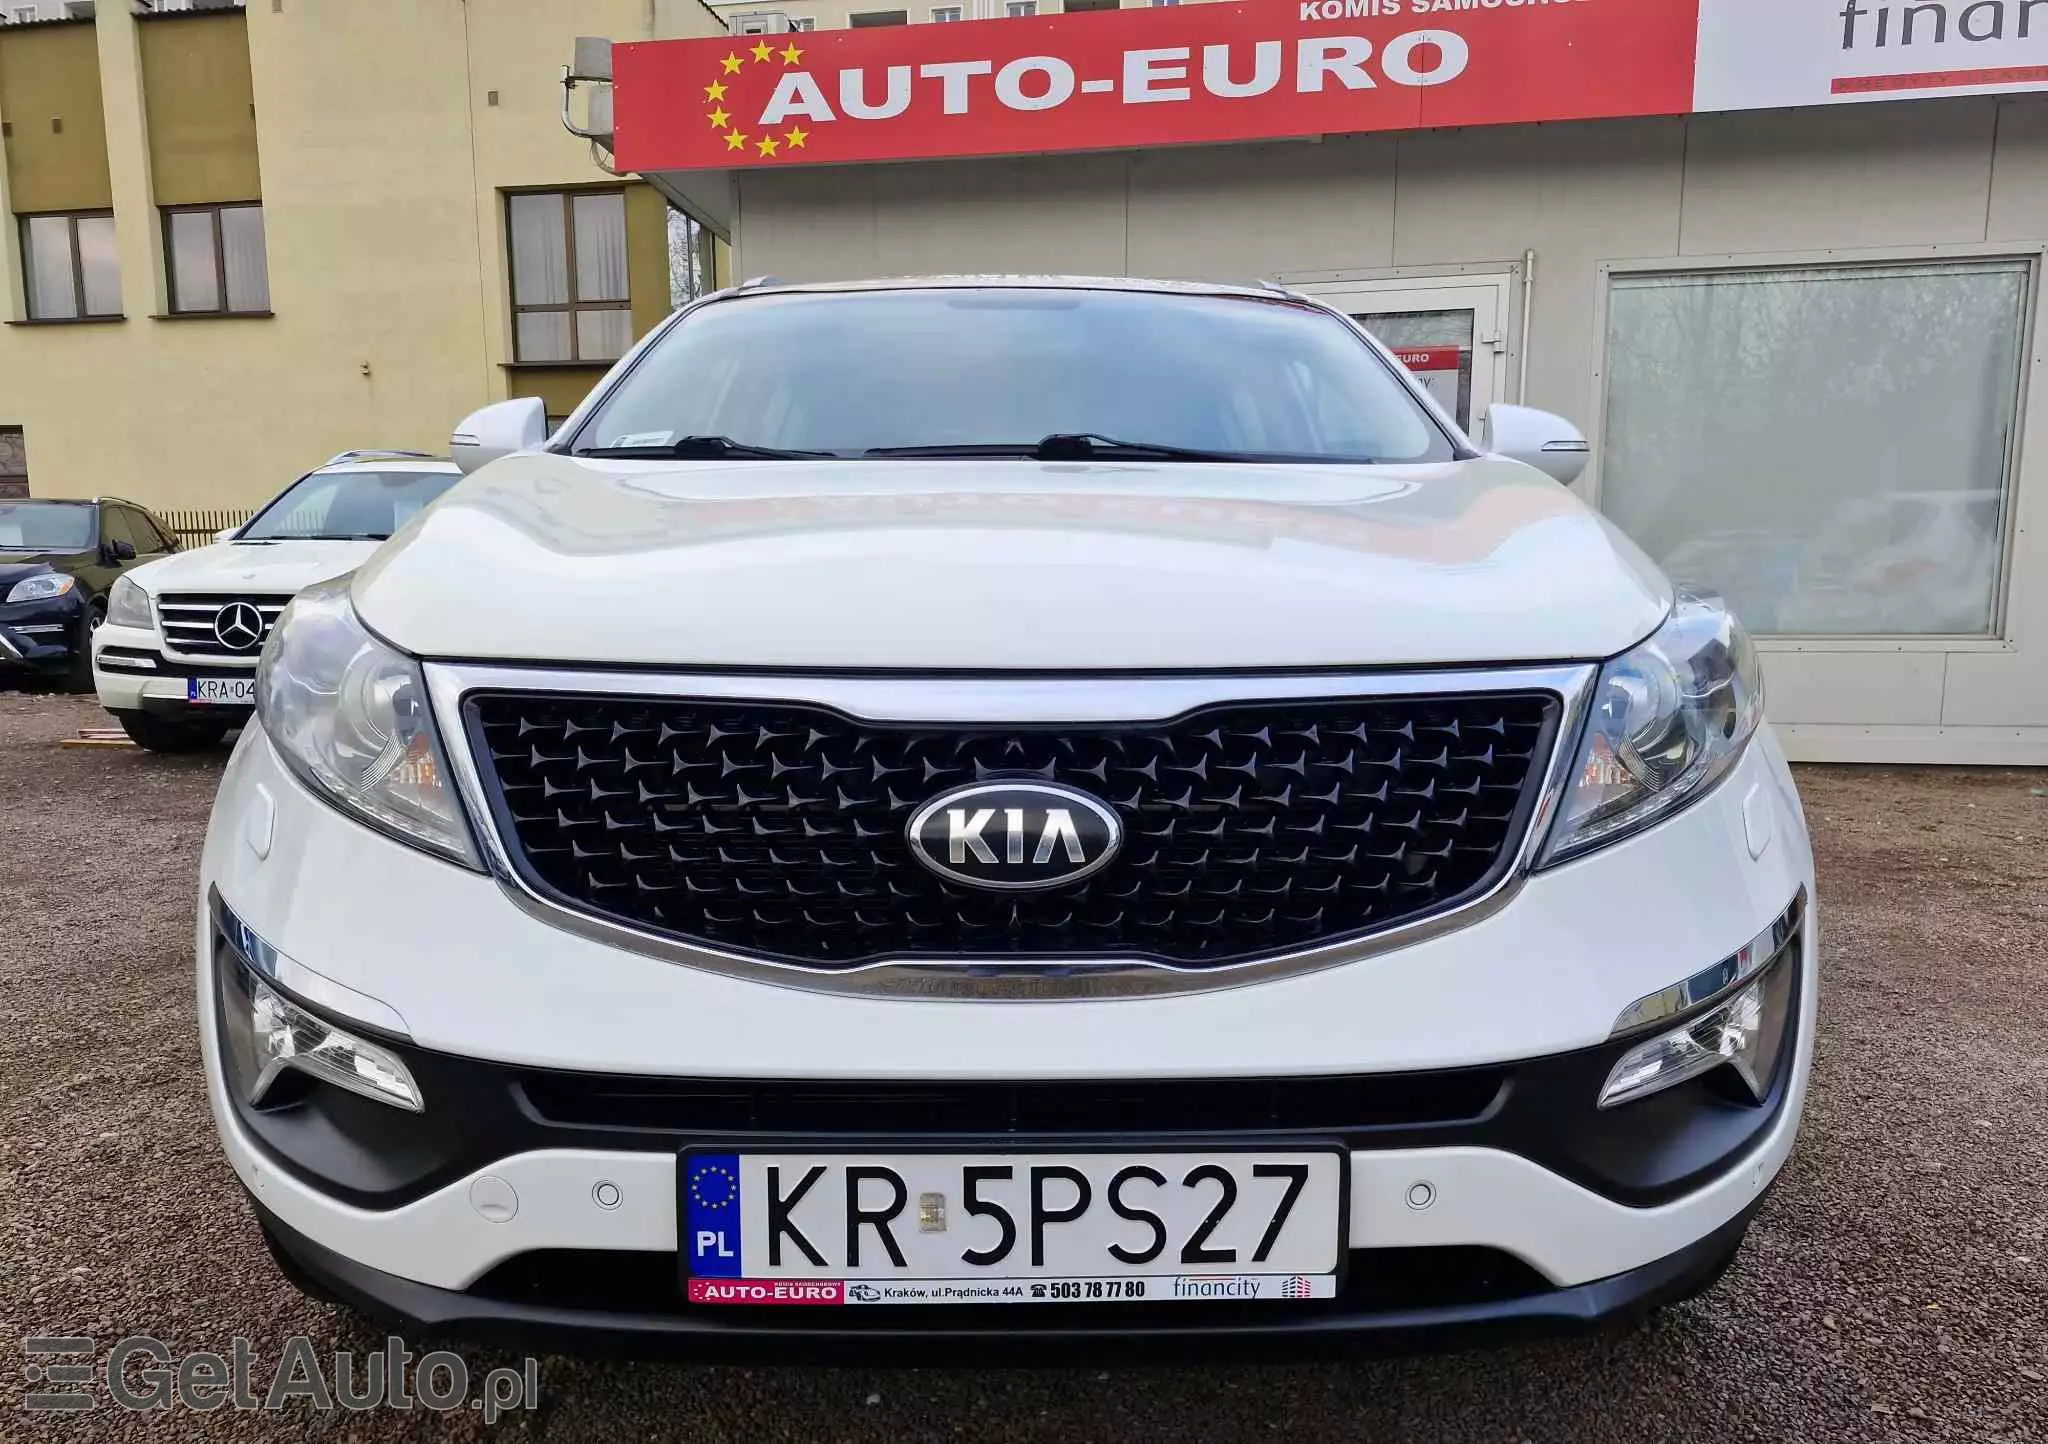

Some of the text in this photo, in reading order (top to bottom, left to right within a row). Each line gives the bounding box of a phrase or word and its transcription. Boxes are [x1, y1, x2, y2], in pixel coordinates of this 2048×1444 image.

[1299, 0, 1401, 21] KOMIS
[758, 29, 1469, 125] AUTO-EURO
[198, 681, 228, 698] KRA
[947, 809, 1086, 864] KIA
[766, 1164, 1309, 1268] KR 5PS27
[696, 1231, 734, 1257] PL
[705, 1286, 837, 1299] AUTO-EURO
[884, 1288, 928, 1299] Kraków,
[1002, 1286, 1024, 1297] 44A
[1050, 1281, 1145, 1299] 503 78 77 80
[1174, 1276, 1261, 1299] financity
